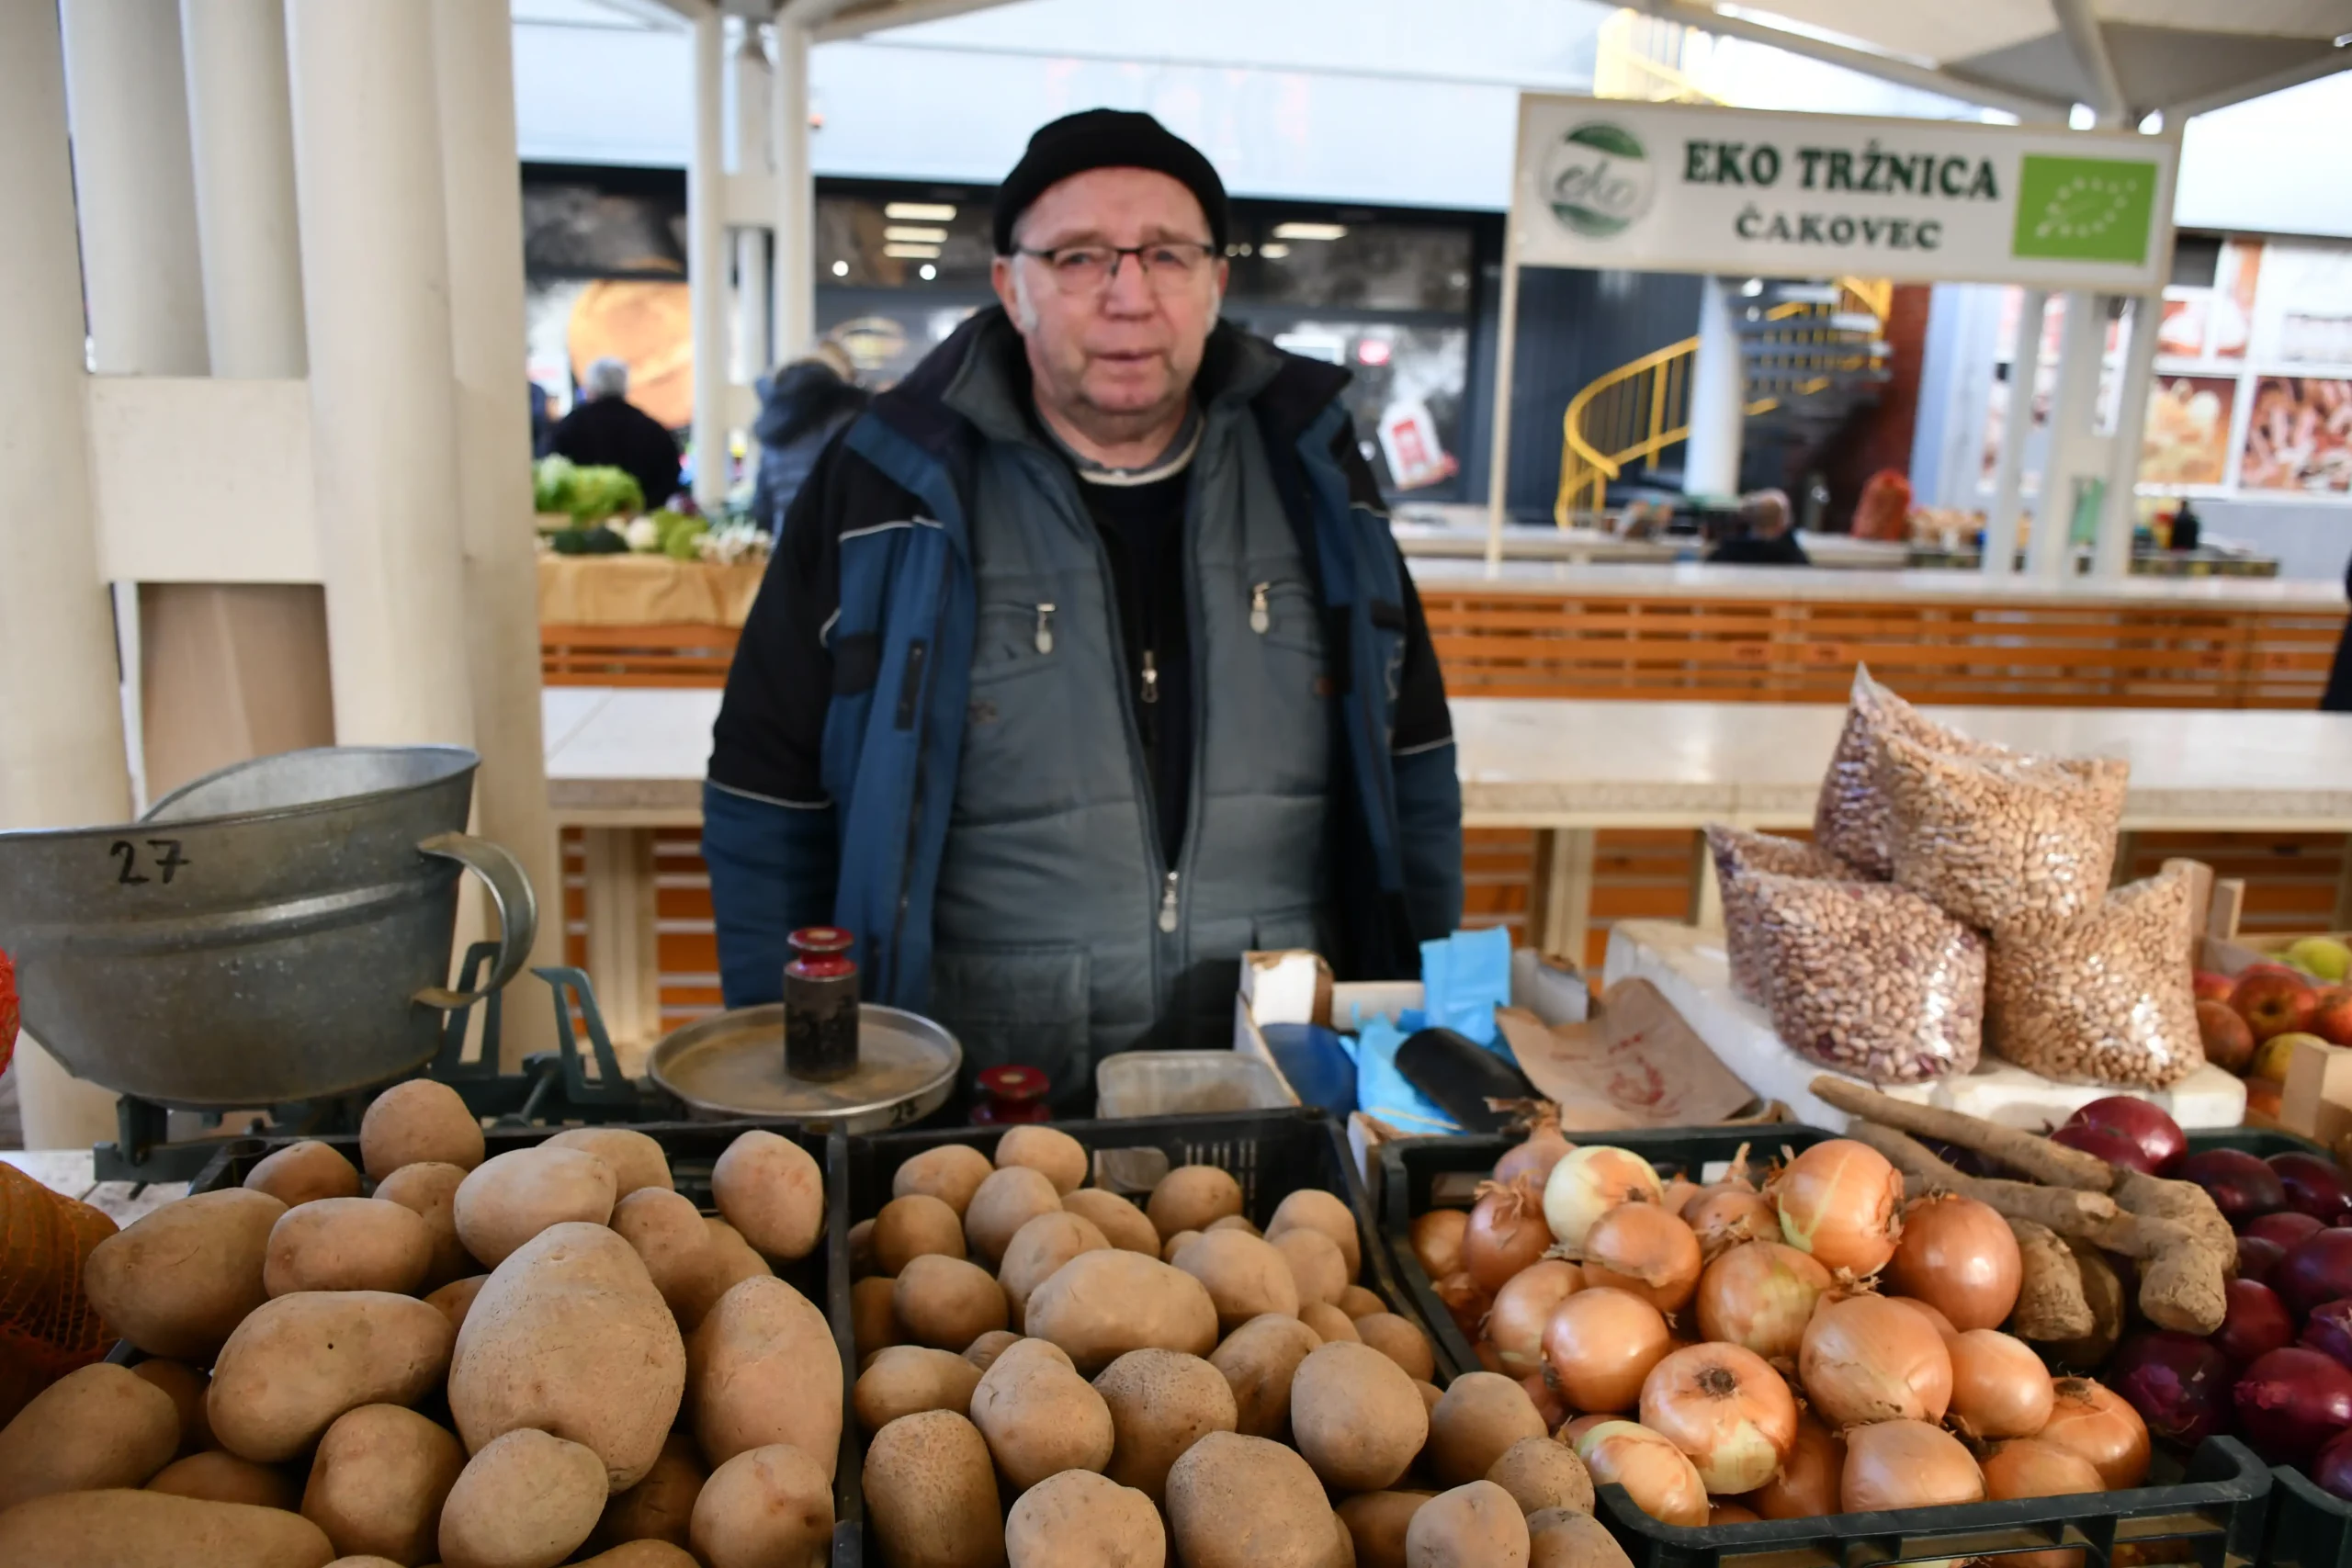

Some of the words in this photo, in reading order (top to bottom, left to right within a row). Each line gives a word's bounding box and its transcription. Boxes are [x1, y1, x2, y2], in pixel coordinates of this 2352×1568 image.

[1683, 140, 1781, 186] EKO
[1796, 138, 2000, 200] TRŽNICA
[1735, 201, 1941, 251] ČAKOVEC
[109, 840, 192, 885] 27
